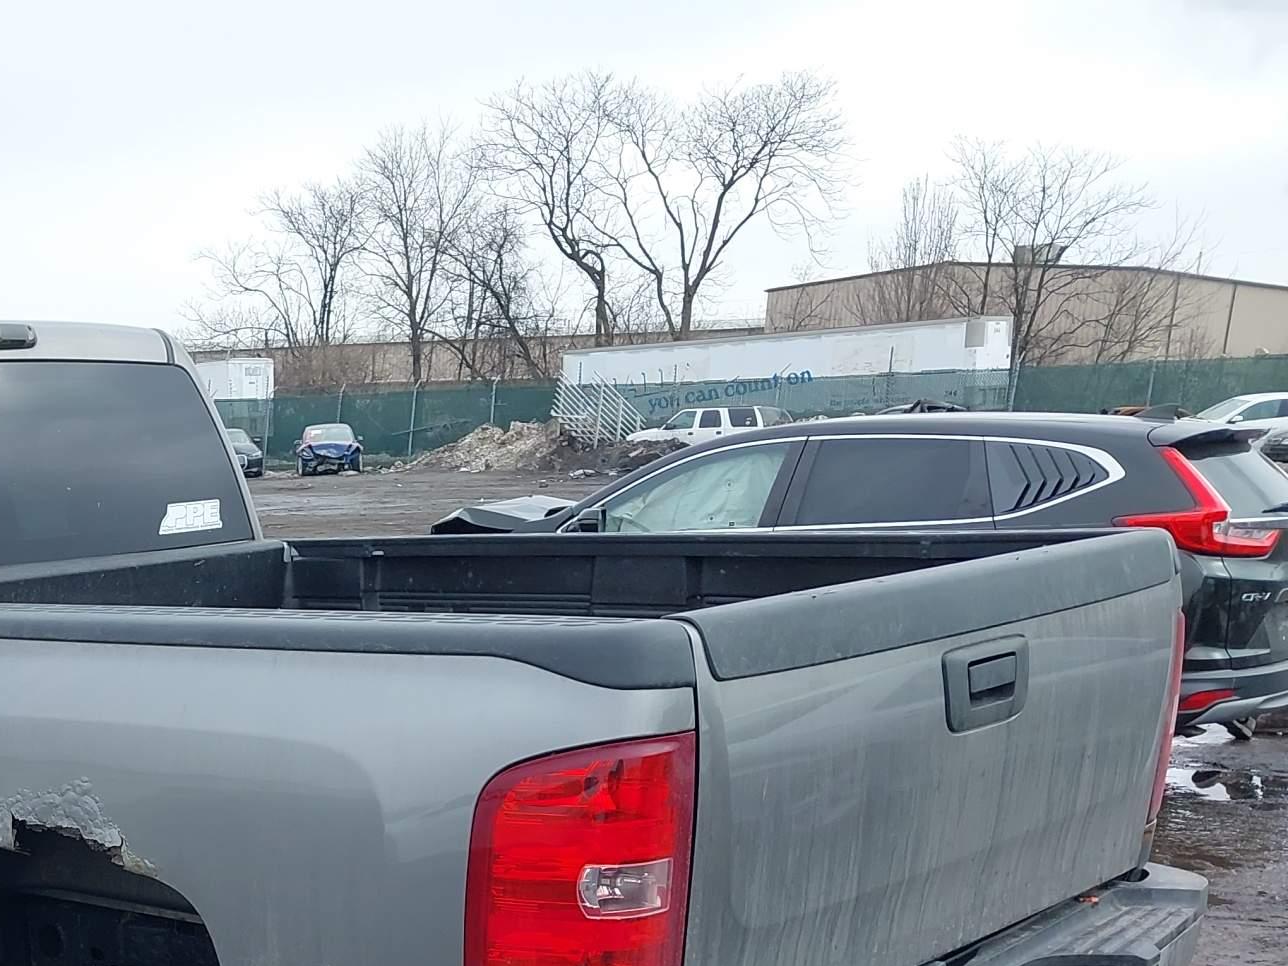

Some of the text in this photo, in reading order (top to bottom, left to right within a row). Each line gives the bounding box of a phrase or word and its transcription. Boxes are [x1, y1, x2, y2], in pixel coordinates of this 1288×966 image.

[648, 369, 813, 415] you can count on
